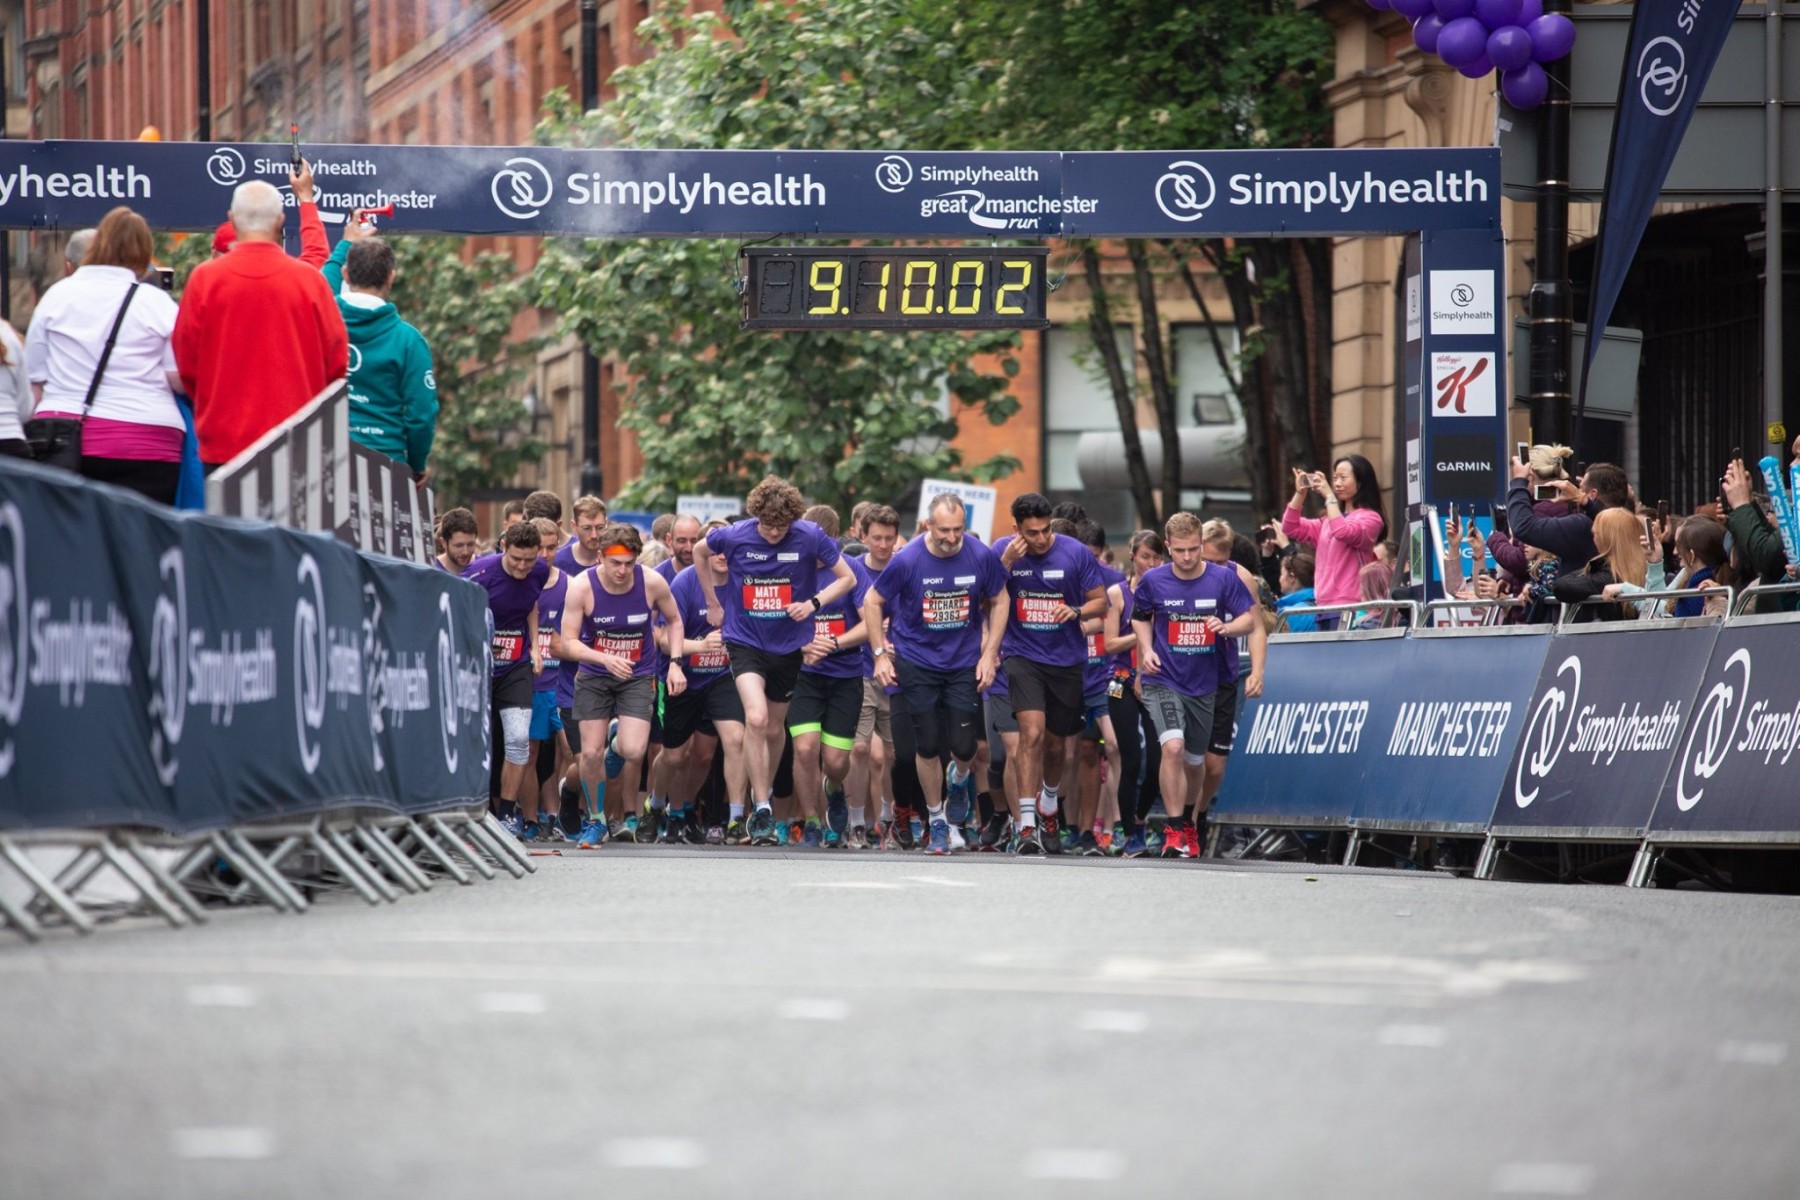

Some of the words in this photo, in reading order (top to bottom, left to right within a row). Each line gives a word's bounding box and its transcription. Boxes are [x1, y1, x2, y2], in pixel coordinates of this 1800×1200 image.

[254, 159, 377, 176] Simyhealth
[921, 166, 1039, 185] Simplyhealth
[567, 172, 826, 214] Simplyhealth
[1229, 170, 1488, 213] Simplyhealth
[920, 196, 968, 217] great
[986, 195, 1099, 214] manchester
[1008, 218, 1040, 229] run
[1433, 311, 1493, 321] Simplyhealth
[1437, 358, 1488, 413] K
[1436, 462, 1491, 472] GARMIN
[746, 552, 768, 561] SPORT
[755, 586, 779, 598] MATT
[928, 599, 965, 611] RICHARD
[932, 610, 960, 622] 29363
[1180, 623, 1205, 634] LOUIS
[597, 639, 640, 650] ALEXANDER
[1177, 634, 1206, 645] 26537
[1245, 701, 1369, 754] MANCHESTER
[1386, 702, 1511, 757] MANCHESTER
[1569, 700, 1681, 765] Simplyhealth
